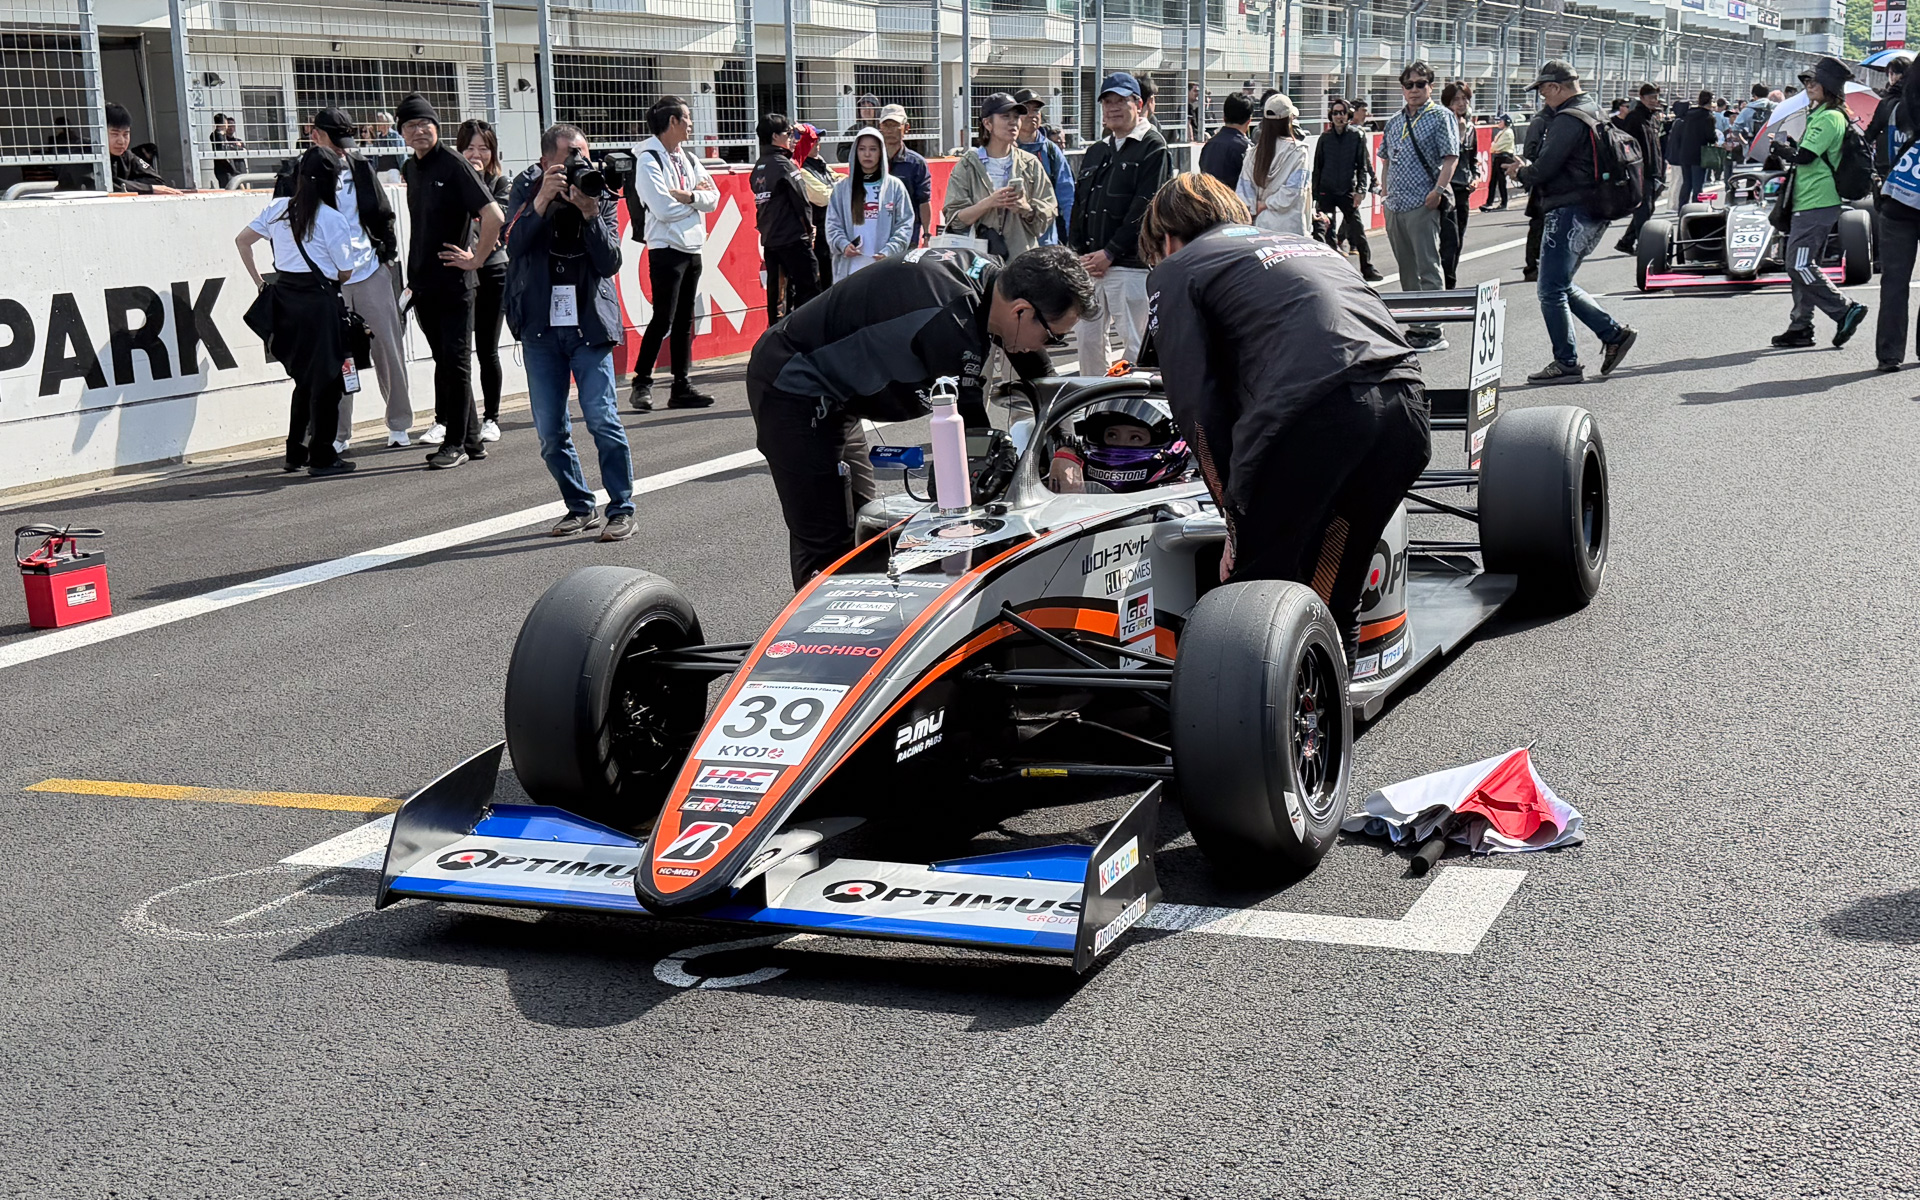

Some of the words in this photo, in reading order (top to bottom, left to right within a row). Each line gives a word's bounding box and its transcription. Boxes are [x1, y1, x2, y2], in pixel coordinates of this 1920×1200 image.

[1734, 234, 1760, 243] 36
[1479, 309, 1496, 365] 39
[1087, 465, 1147, 481] BRIDGESTONE
[1122, 562, 1151, 584] HOMES
[796, 645, 883, 658] NICHIBO
[722, 695, 825, 742] 39
[897, 741, 924, 763] RACING
[924, 733, 943, 750] PADS
[699, 769, 773, 786] HRC
[436, 848, 638, 879] OPTIMU
[659, 867, 698, 876] KC-MG01
[822, 880, 1082, 917] OPTIMUS
[1026, 914, 1078, 925] GROUP
[1096, 896, 1146, 953] BRIDGESTONE
